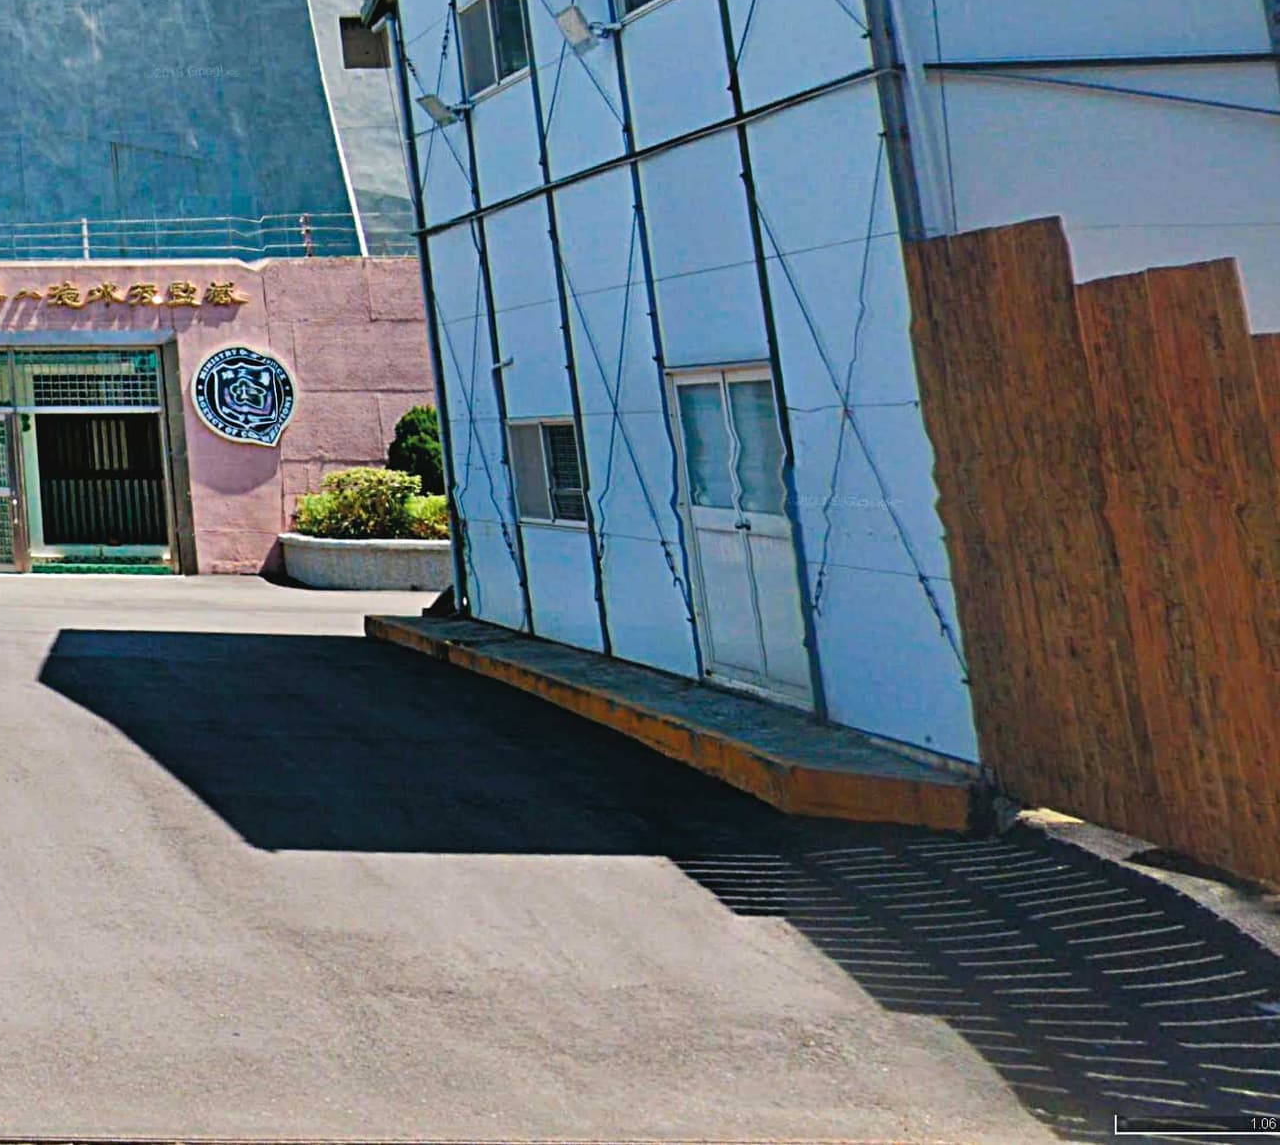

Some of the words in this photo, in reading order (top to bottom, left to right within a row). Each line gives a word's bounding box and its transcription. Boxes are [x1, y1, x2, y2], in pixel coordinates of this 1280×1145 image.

[200, 349, 238, 380] MINISTRY
[198, 396, 225, 429] AGENCY
[225, 427, 239, 436] OF
